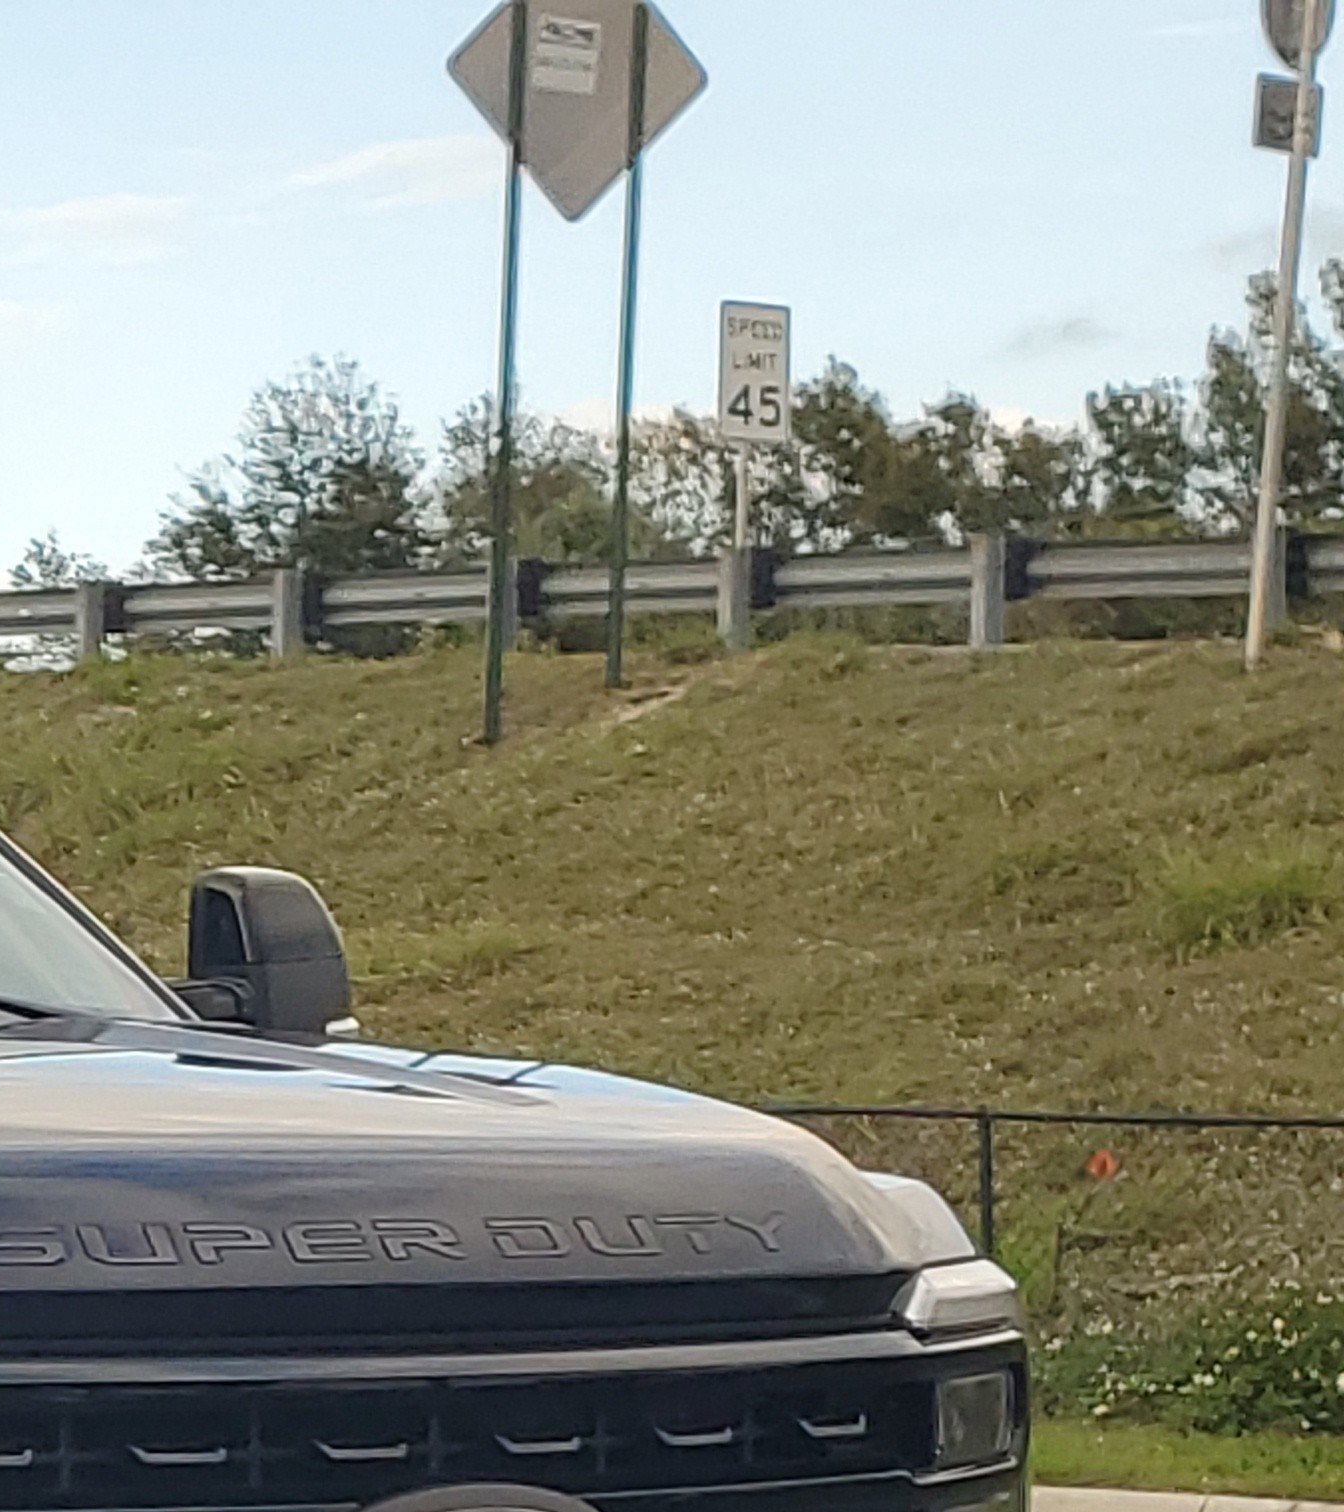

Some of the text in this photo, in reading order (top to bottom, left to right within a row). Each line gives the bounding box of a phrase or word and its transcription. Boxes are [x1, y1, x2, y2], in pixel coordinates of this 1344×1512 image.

[727, 316, 782, 341] SPEED
[733, 351, 778, 371] LIMIT
[727, 384, 781, 427] 45
[484, 1210, 788, 1261] DUTY
